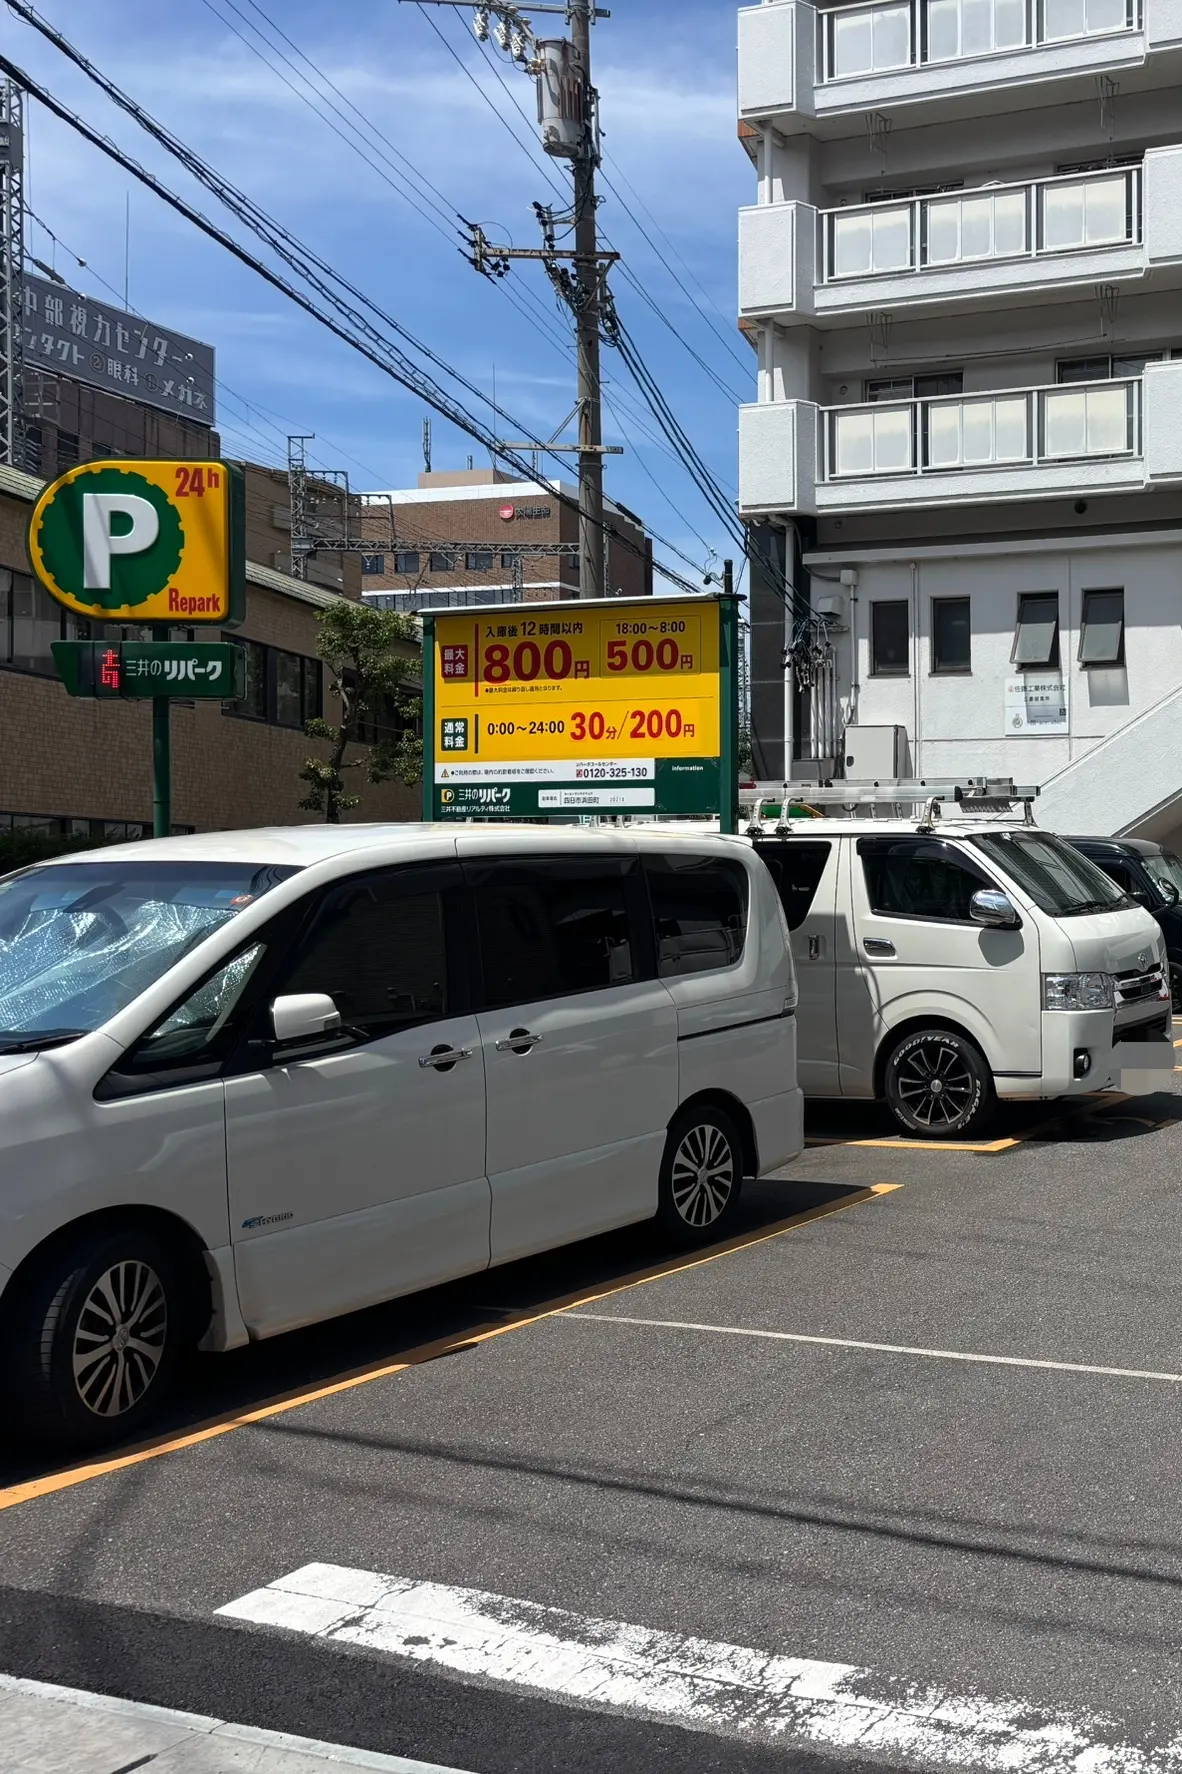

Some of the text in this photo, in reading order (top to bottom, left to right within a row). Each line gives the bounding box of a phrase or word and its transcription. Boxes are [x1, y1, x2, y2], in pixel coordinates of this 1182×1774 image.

[175, 467, 219, 497] 24h
[83, 493, 159, 589] P
[168, 588, 220, 615] Repark
[444, 648, 465, 661] 最大
[483, 639, 590, 684] 800円
[606, 637, 693, 671] 500円
[125, 658, 222, 681] 三井のリパーク
[444, 662, 465, 675] 料金
[444, 721, 465, 734] 通常
[444, 735, 465, 748] 料金
[583, 767, 648, 779] 0120-325-130
[458, 786, 511, 803] 三井のリパーク
[441, 805, 511, 813] 三井不動産リアルティ株式会社
